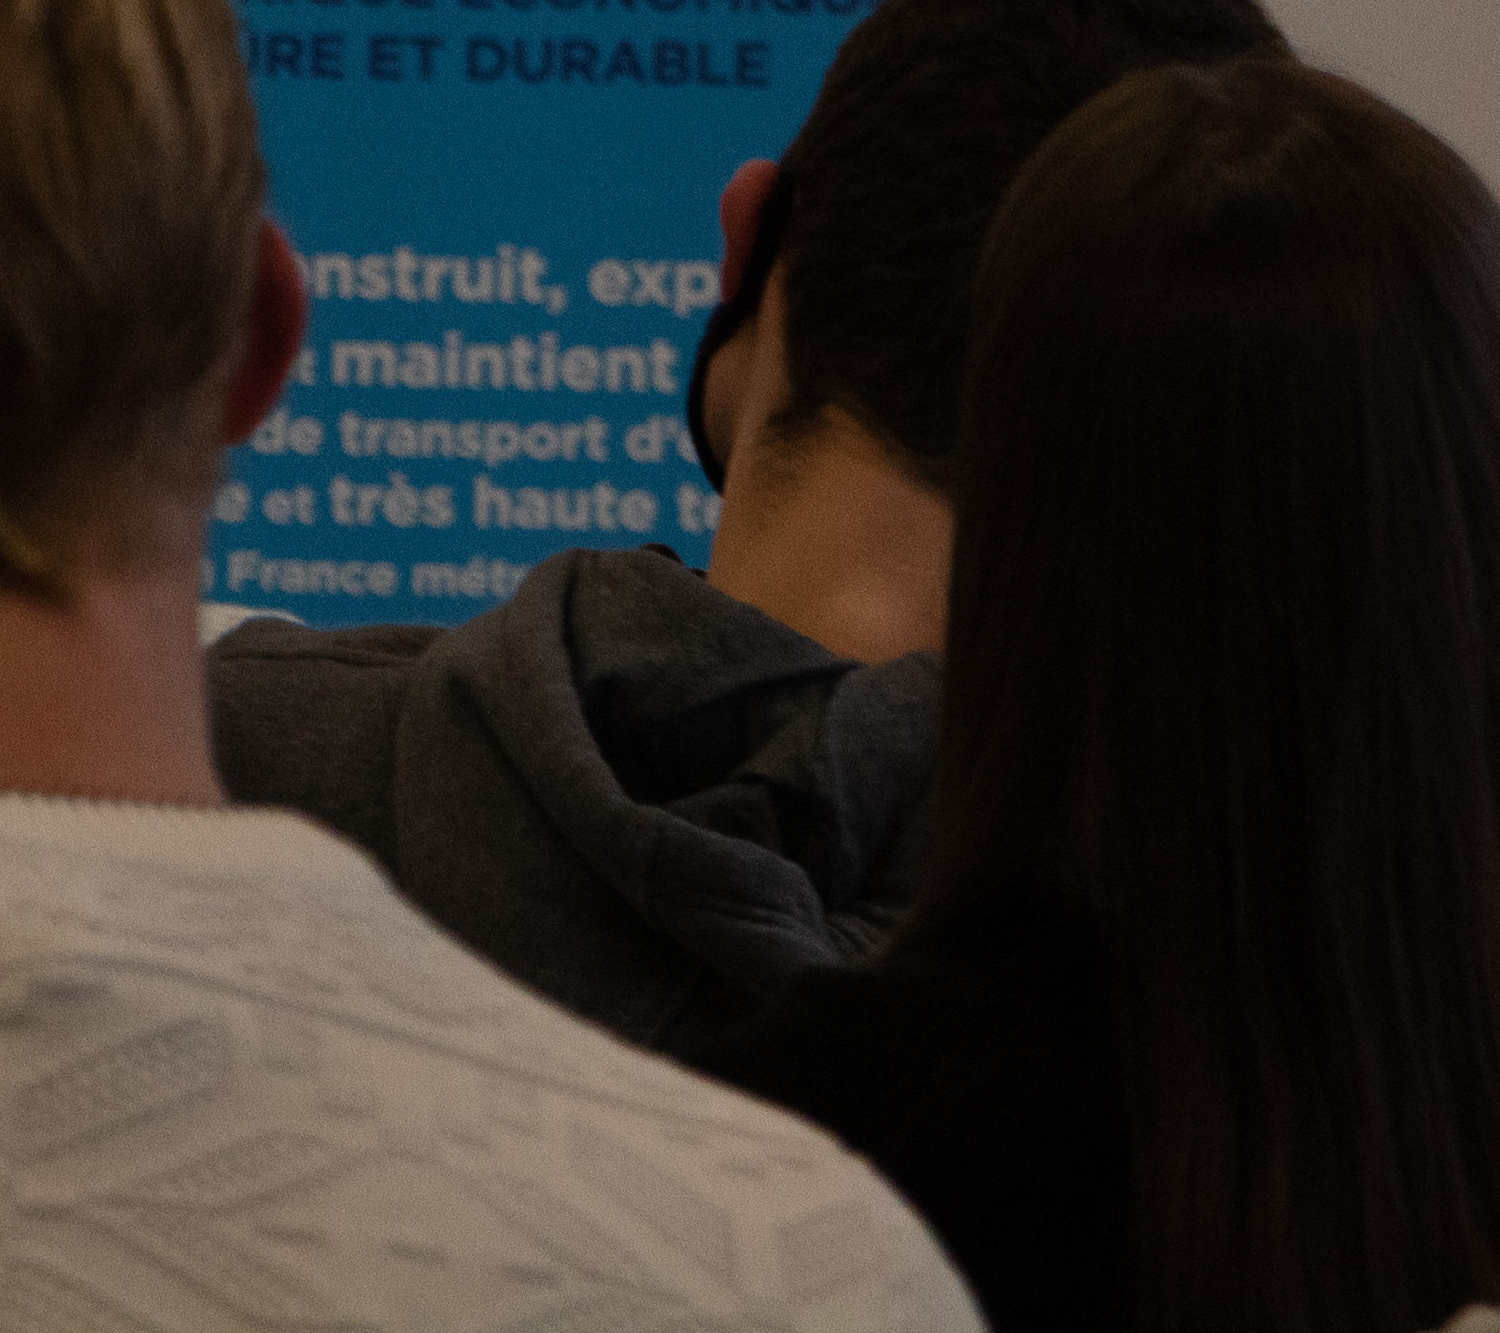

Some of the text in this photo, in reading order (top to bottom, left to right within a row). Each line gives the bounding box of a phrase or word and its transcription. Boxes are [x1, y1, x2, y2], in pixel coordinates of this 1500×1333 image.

[367, 34, 442, 83] ET
[466, 36, 770, 88] DURABLE
[298, 242, 568, 315] nstruit,
[329, 330, 679, 394] maintient
[251, 408, 324, 456] de
[337, 409, 609, 467] transport
[261, 484, 315, 526] et
[329, 471, 456, 528] très
[472, 474, 658, 534] haute
[225, 548, 397, 597] France
